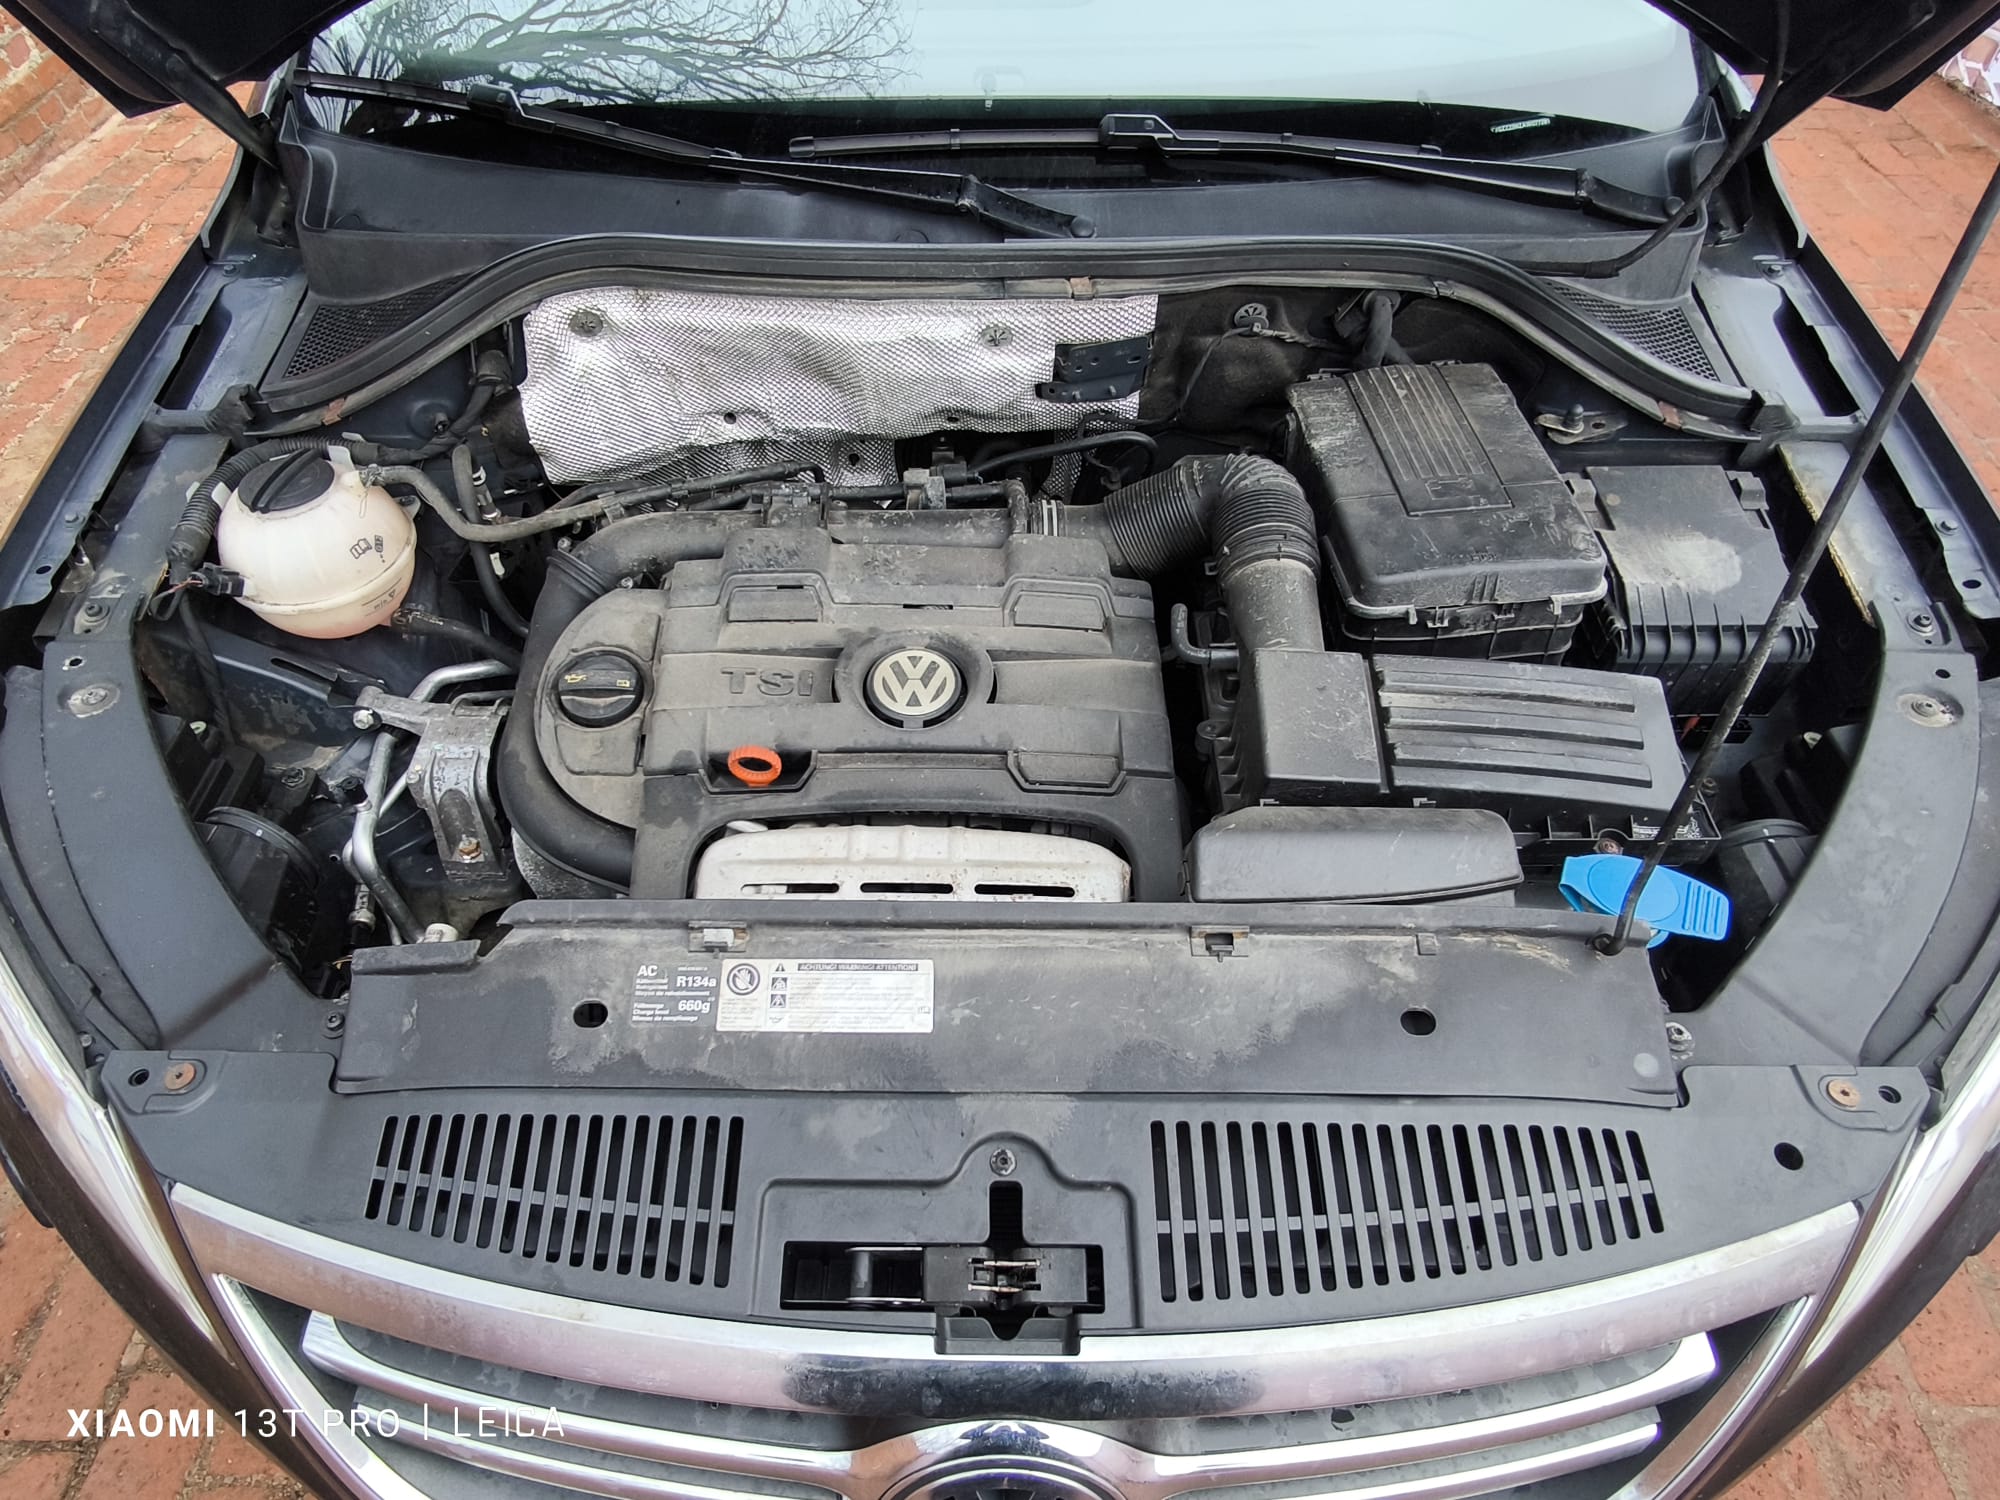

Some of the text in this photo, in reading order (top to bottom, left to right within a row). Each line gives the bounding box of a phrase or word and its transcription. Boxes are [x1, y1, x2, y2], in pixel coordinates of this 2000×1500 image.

[721, 667, 814, 697] TSI
[873, 650, 956, 716] VW
[637, 965, 658, 977] AC
[676, 976, 717, 988] R134a
[678, 1000, 711, 1014] 660g
